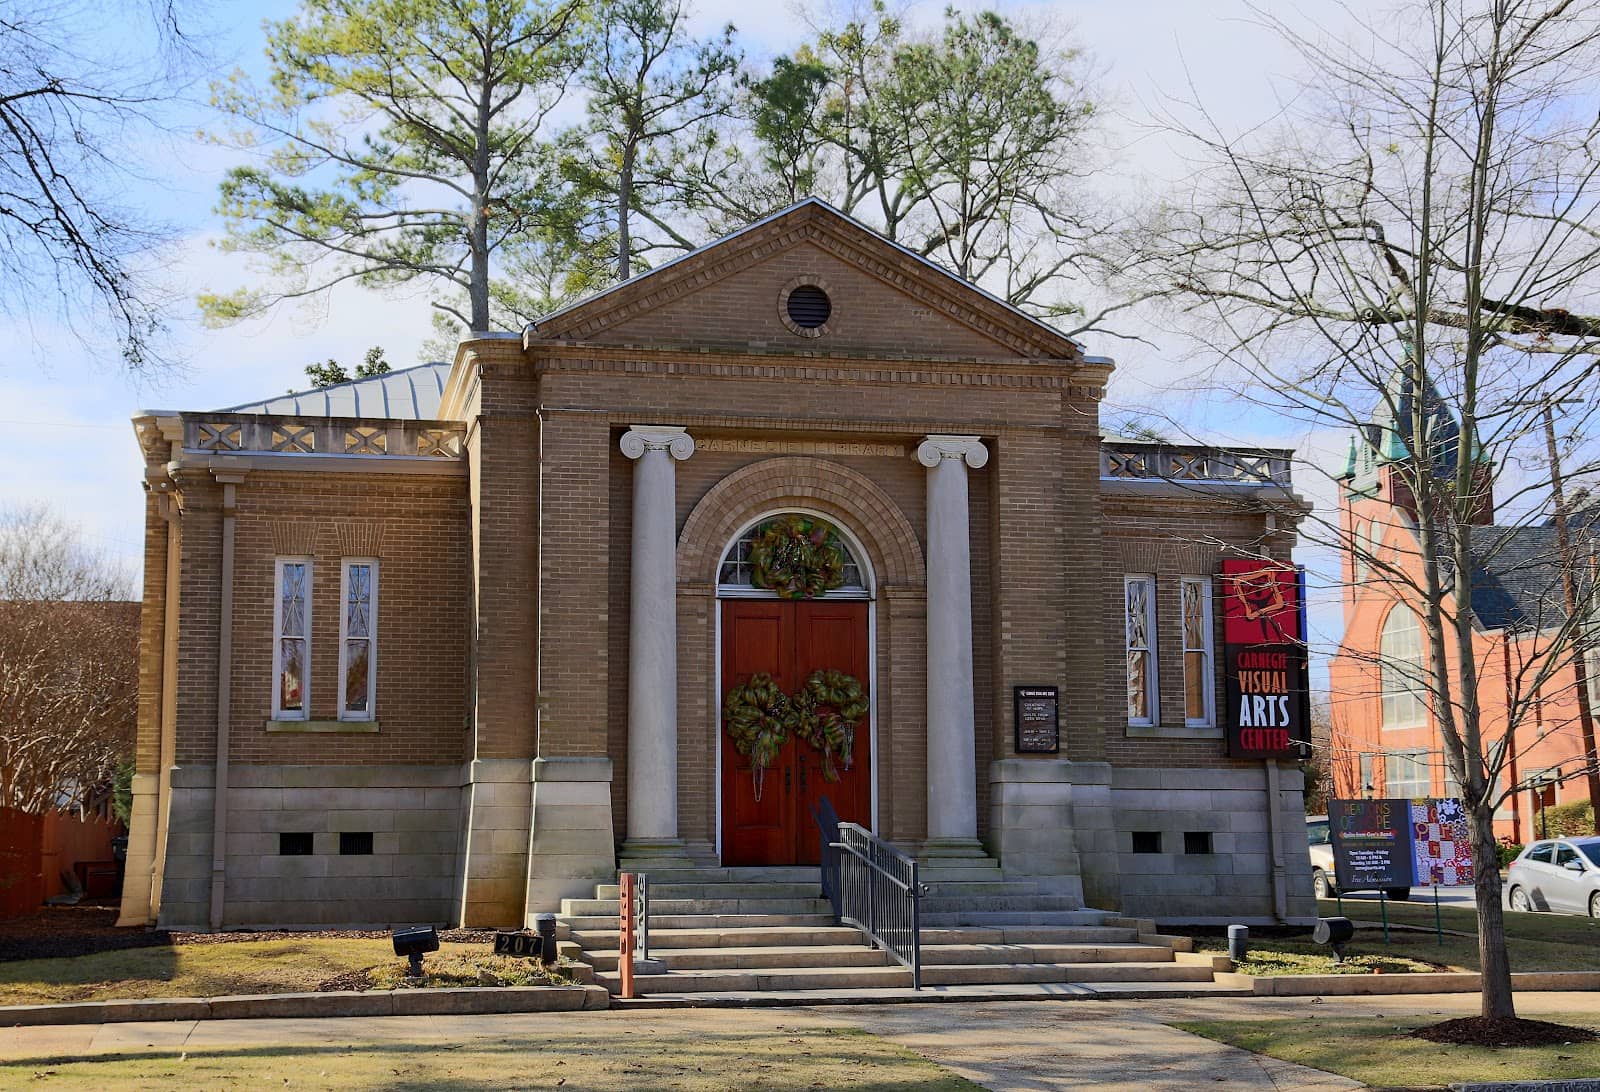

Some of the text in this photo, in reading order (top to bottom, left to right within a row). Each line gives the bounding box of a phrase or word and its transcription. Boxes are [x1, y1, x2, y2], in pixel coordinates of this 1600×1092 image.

[694, 440, 801, 454] CARNEGIE
[1238, 652, 1287, 669] CARNEGIE
[1238, 670, 1288, 694] VISUAL
[1239, 694, 1290, 727] ARTS
[1241, 728, 1290, 750] CENTER
[1359, 814, 1392, 830] OPE
[500, 935, 537, 953] 207
